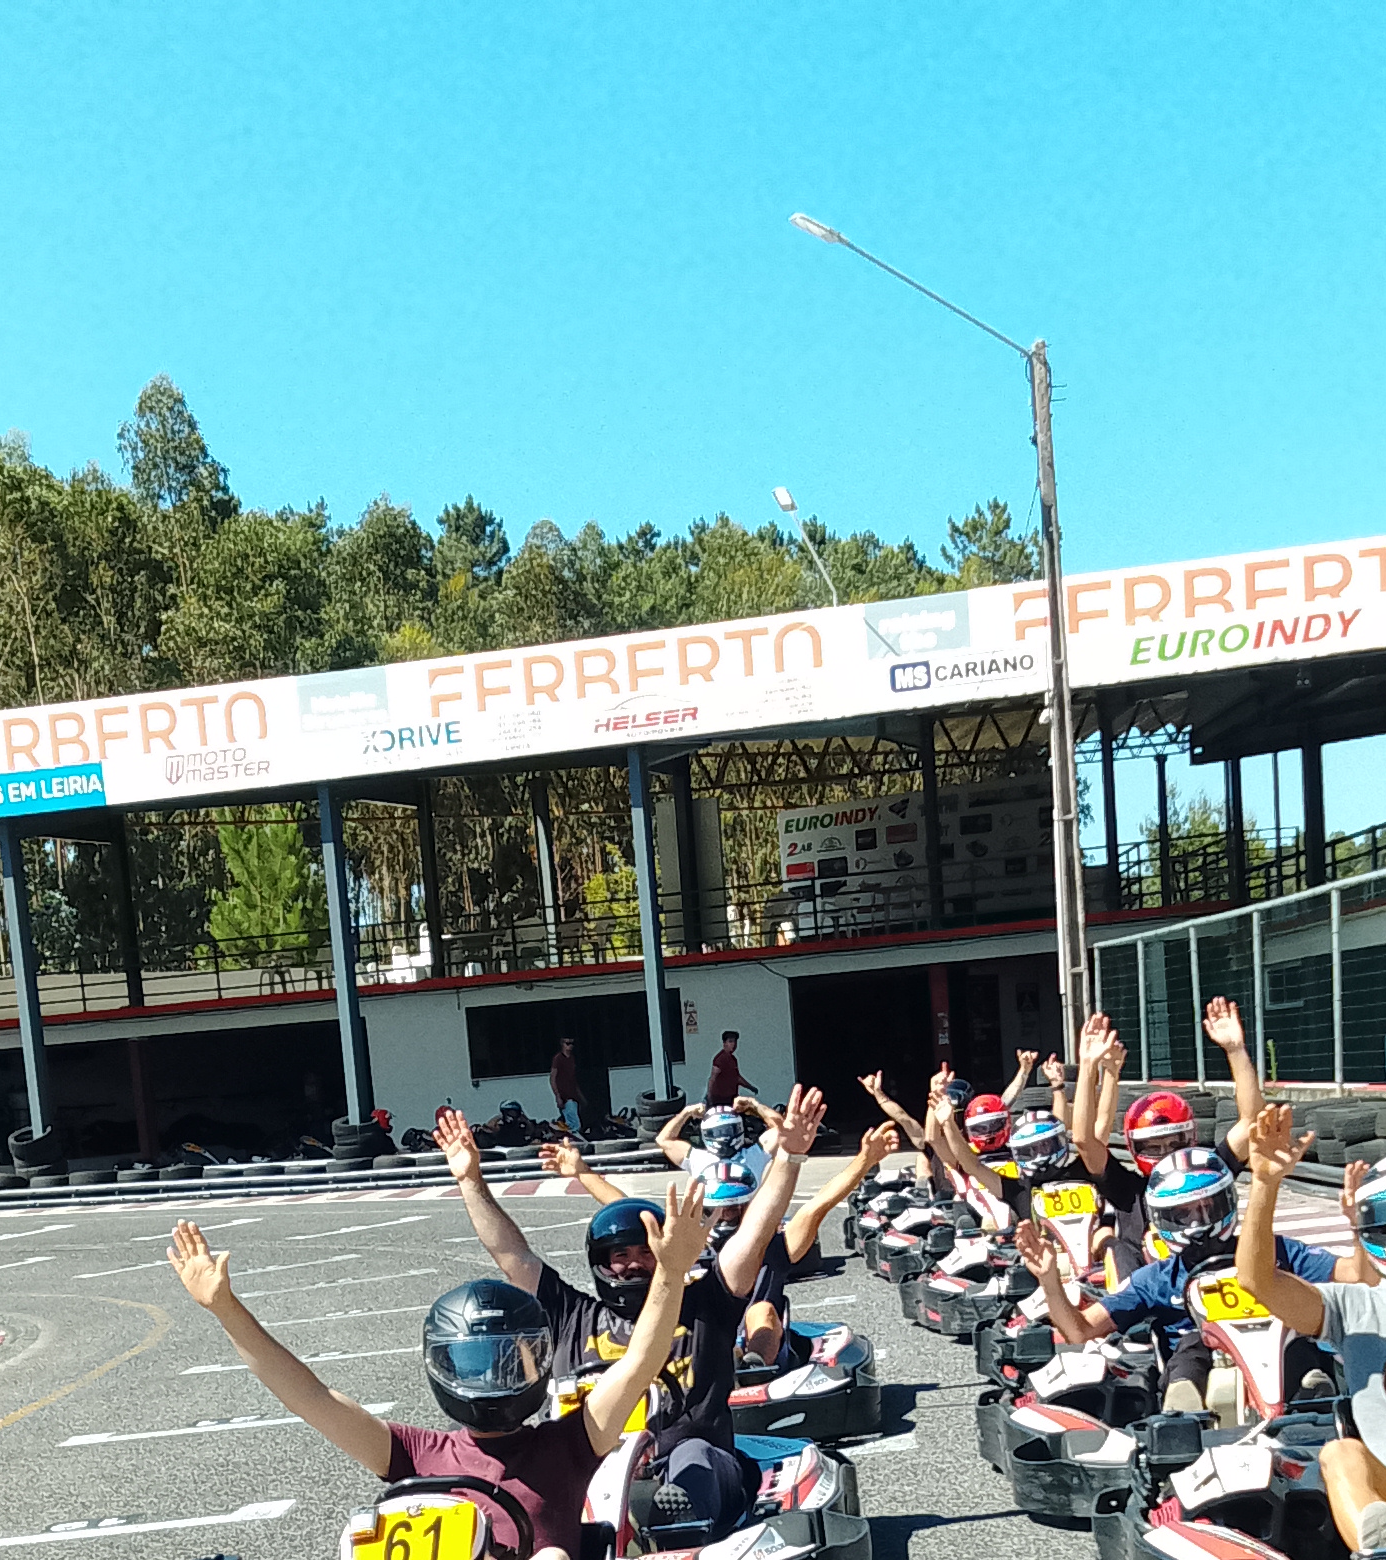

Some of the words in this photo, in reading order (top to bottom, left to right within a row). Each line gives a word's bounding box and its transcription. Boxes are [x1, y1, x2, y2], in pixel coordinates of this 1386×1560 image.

[1129, 607, 1363, 666] EUROINDY
[894, 665, 930, 691] MS
[934, 653, 1035, 682] CARIANO
[186, 747, 247, 767] MOTO
[8, 780, 36, 803] EM
[39, 773, 104, 800] LEIRIA
[783, 805, 880, 835] EUROINDY
[1052, 1191, 1082, 1213] 80
